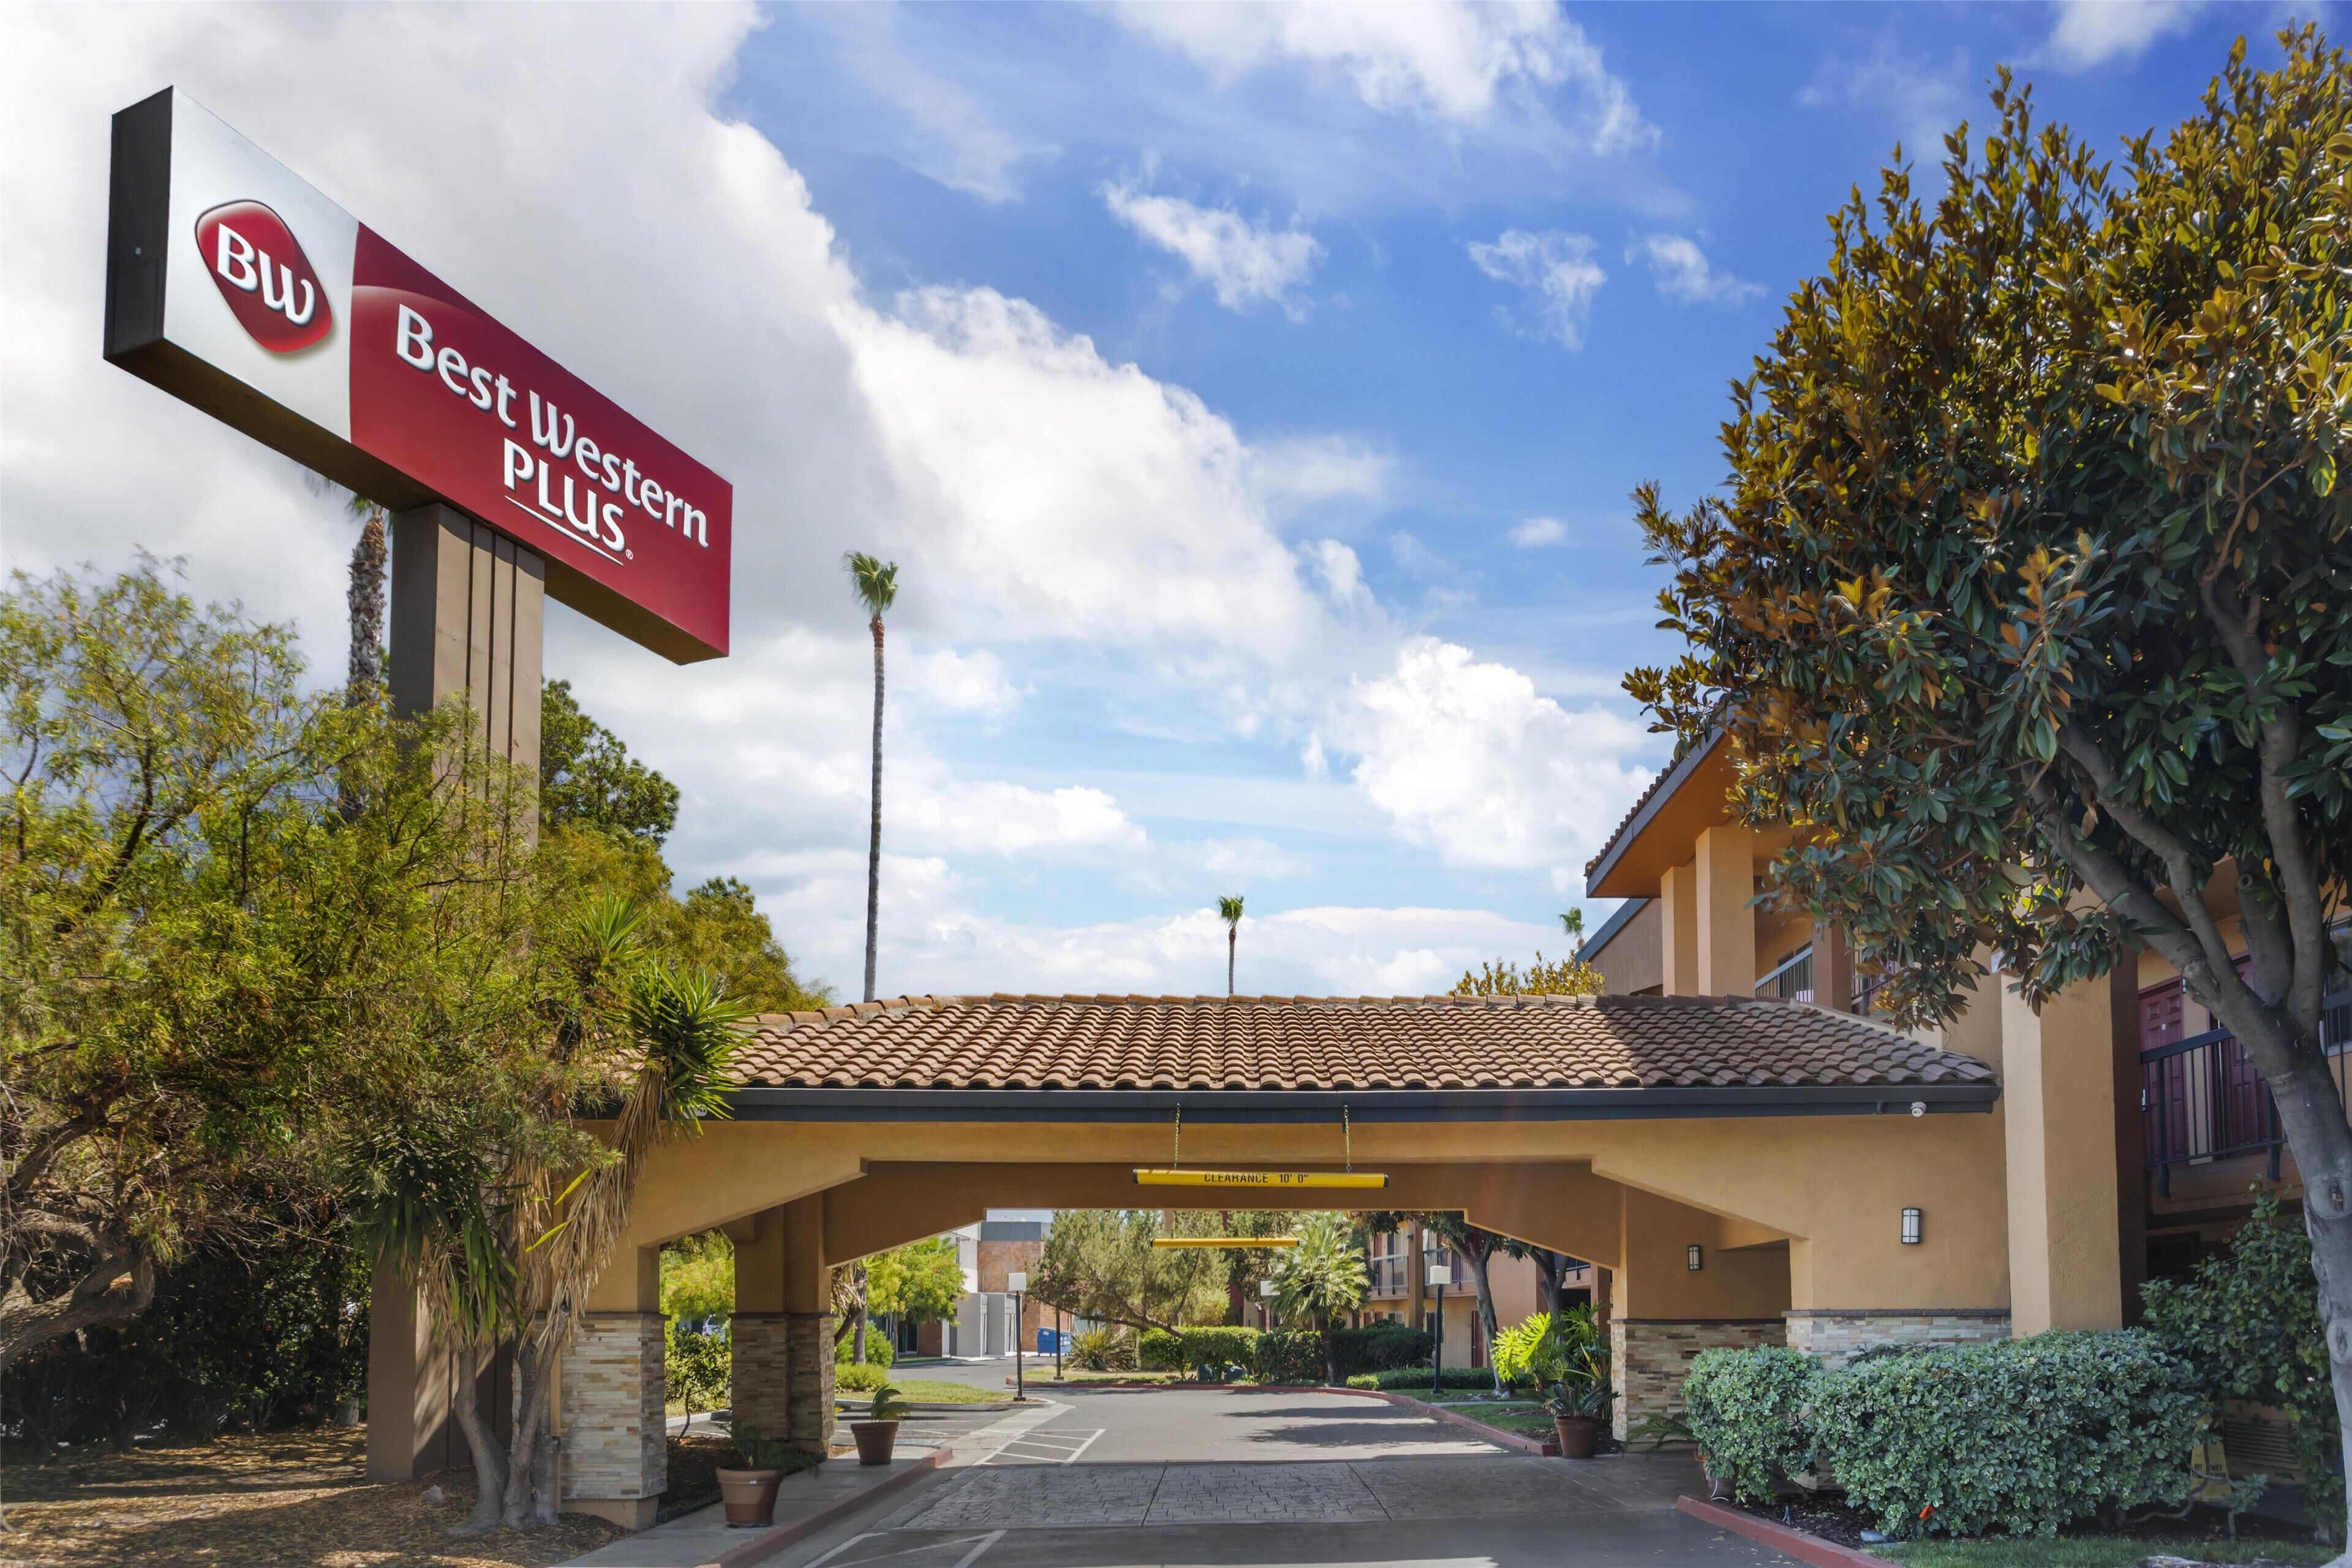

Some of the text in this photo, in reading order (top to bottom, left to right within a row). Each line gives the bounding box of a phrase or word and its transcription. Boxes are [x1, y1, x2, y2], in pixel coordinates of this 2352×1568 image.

[217, 222, 315, 324] BW
[397, 303, 709, 548] Best Western
[503, 437, 625, 551] PLUS
[1204, 1173, 1268, 1183] CLEARANCE
[1279, 1174, 1292, 1183] 10'
